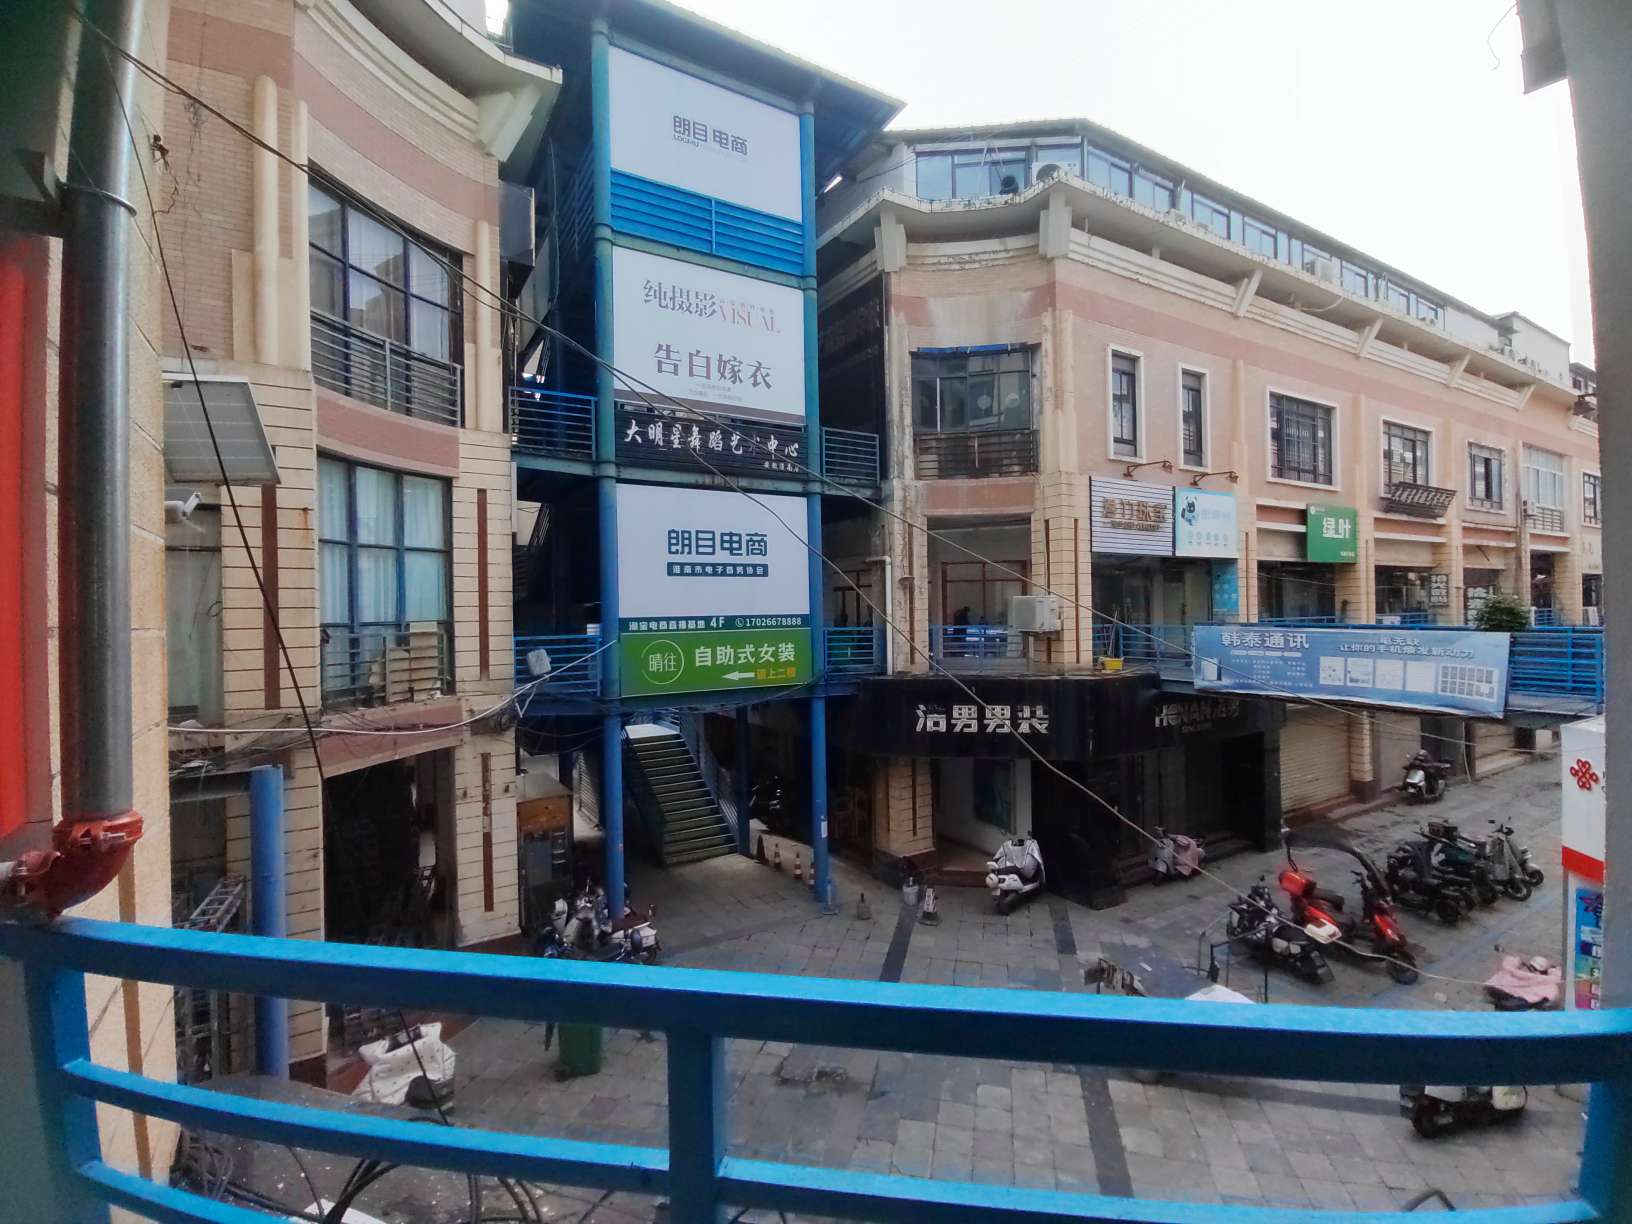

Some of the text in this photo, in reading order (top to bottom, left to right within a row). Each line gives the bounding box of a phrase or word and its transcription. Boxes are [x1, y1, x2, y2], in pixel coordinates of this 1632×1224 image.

[672, 115, 748, 155] 朗目电商
[642, 279, 718, 318] 纯摄影
[654, 343, 773, 389] 告白嫁衣
[667, 529, 768, 557] 朗目电商
[710, 617, 725, 629] 4F
[746, 617, 802, 627] 17026678888
[695, 642, 796, 667] 自助式女装
[1221, 632, 1310, 649] 韩泰通讯
